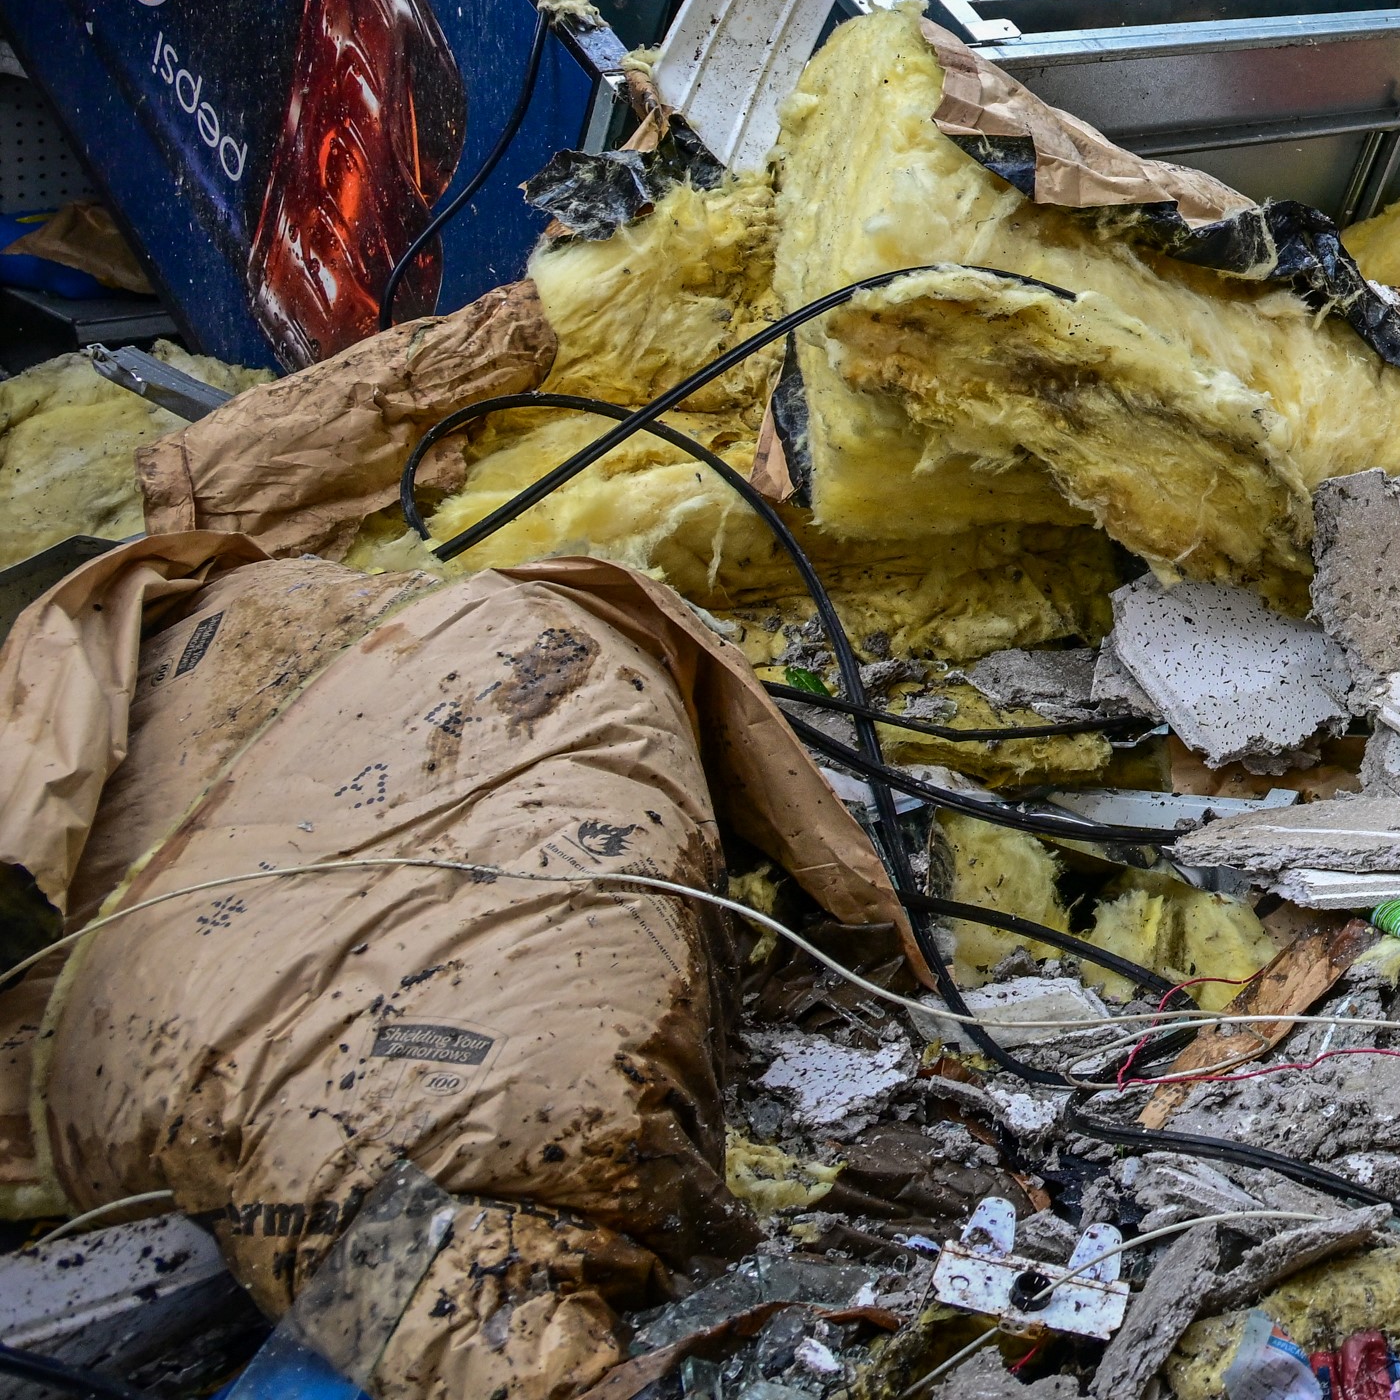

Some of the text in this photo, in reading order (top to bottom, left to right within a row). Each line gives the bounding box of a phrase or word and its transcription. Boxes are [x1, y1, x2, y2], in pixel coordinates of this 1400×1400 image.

[151, 30, 248, 182] pepsi
[380, 1027, 491, 1050] Shielding Your
[385, 1041, 472, 1063] Tomorrows
[425, 1076, 461, 1089] 100
